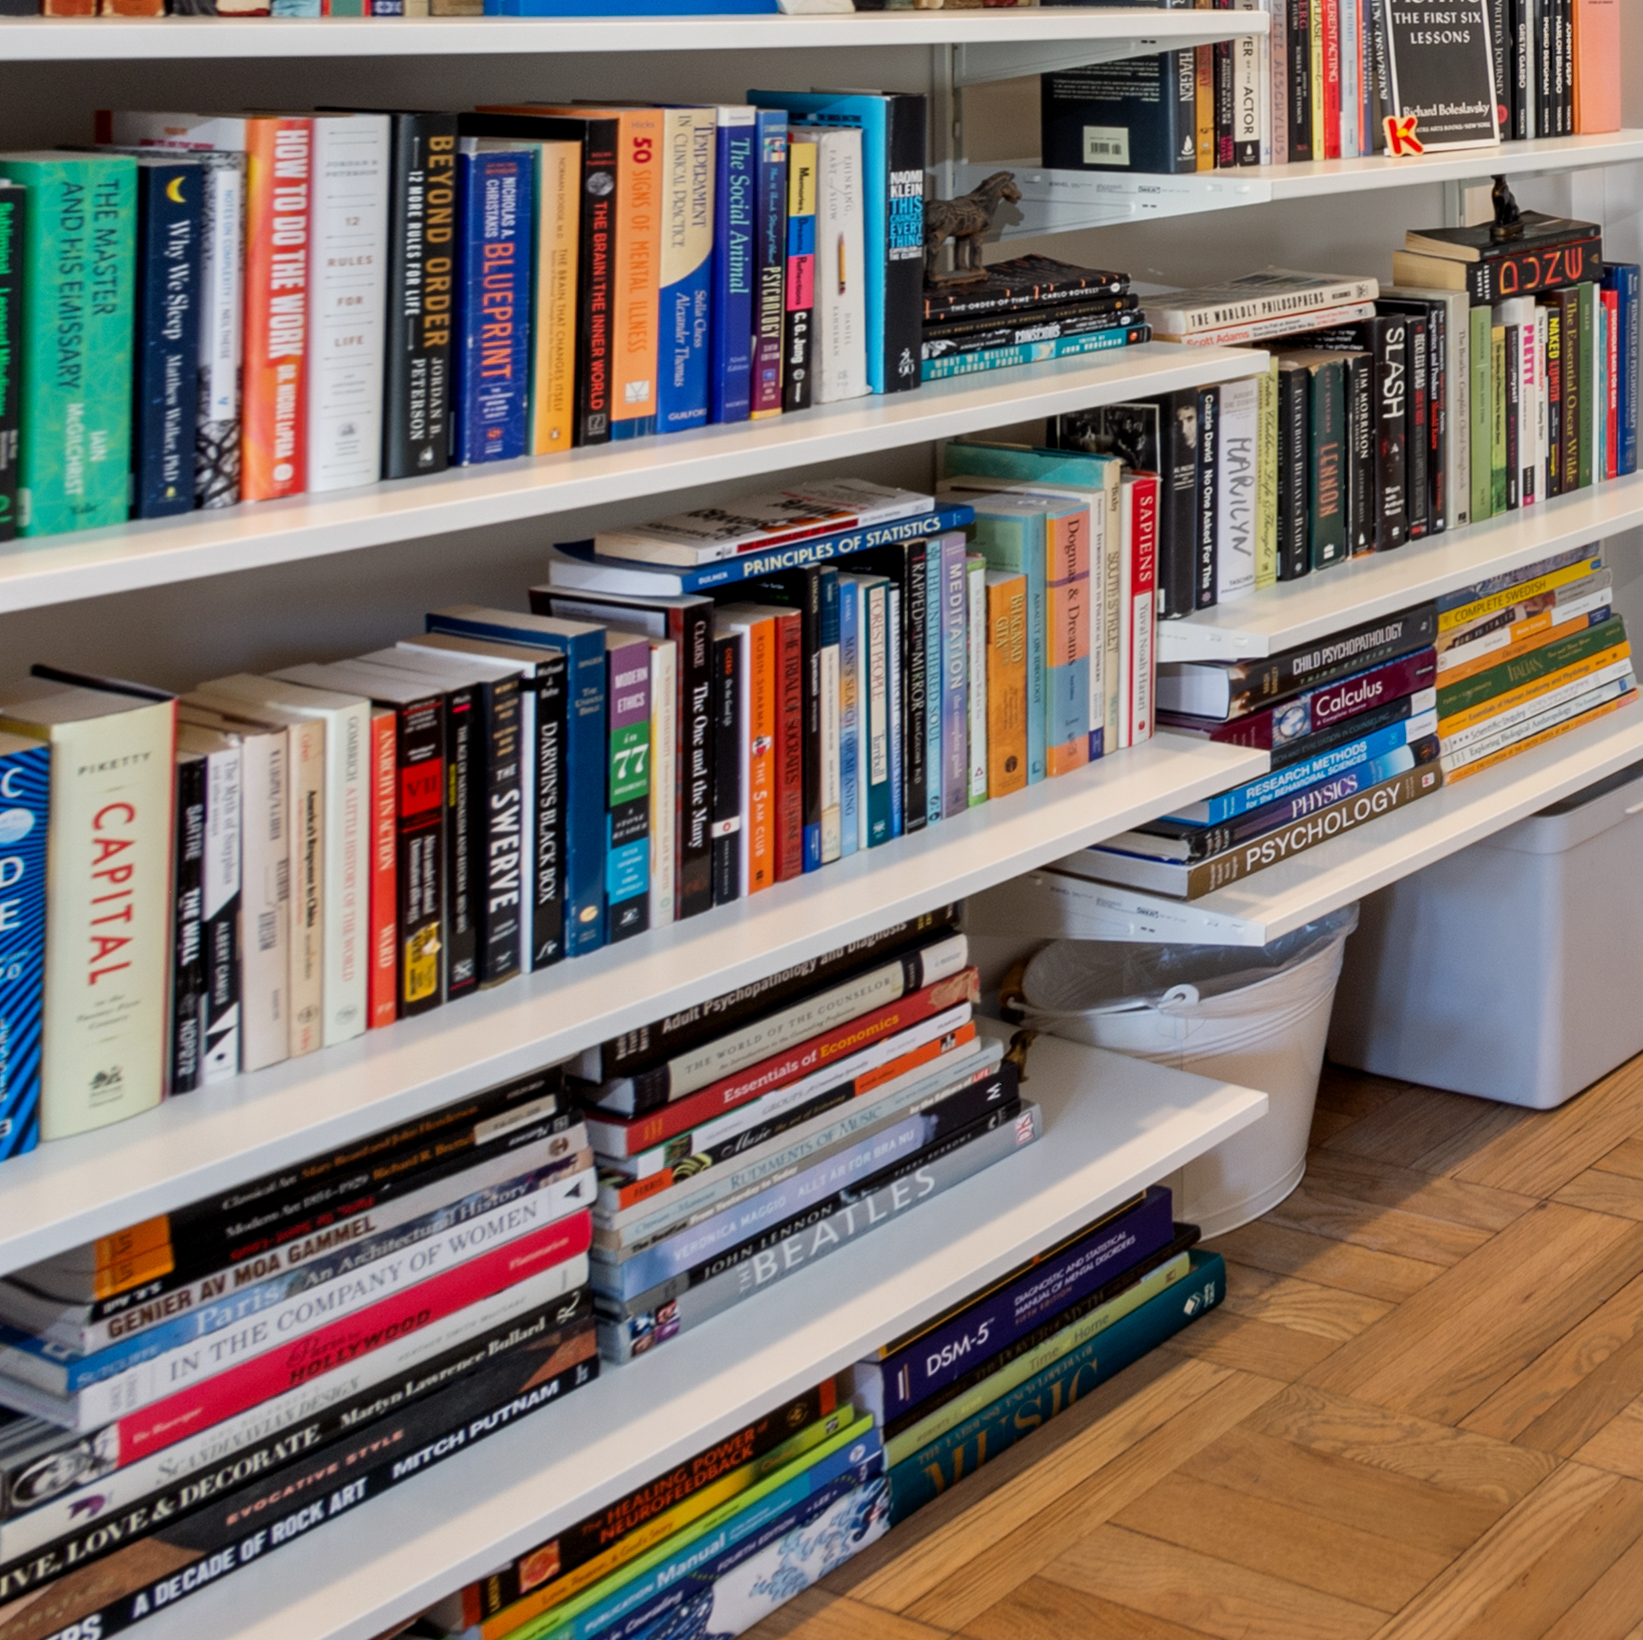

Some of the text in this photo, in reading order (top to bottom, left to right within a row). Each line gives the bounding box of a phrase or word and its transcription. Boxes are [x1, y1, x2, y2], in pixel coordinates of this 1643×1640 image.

[1394, 12, 1481, 24] THE FIRST SIX
[1410, 31, 1470, 44] LESSONS
[1179, 52, 1193, 102] HAGEN
[1402, 101, 1490, 117] Richard Boleslavsky
[633, 137, 653, 164] 50
[890, 171, 923, 185] NAOMI
[728, 139, 749, 294] The Social Animal
[890, 184, 922, 198] KLEIN
[890, 197, 922, 214] THIS
[890, 223, 922, 235] EVERY
[92, 179, 119, 316] THE MASTER
[162, 220, 190, 340] Why We Sleep
[269, 131, 309, 358] HOW TO DO THE WORK
[424, 135, 454, 349] BEYOND ORDER
[889, 235, 923, 246] THING
[57, 182, 84, 392] AND HIS EMISSARY
[481, 242, 514, 379] BLUEPRINT
[761, 266, 781, 338] PSYCHOLOGY
[1190, 292, 1325, 327] THE WORLDLY PHILOSOPHERS
[1382, 327, 1404, 419] SLASH
[743, 517, 941, 577] PRINCIPLES OF STATISTICS
[1139, 496, 1153, 583] SAPIENS
[1454, 579, 1547, 624] COMPLETE SWEDISH
[1292, 622, 1403, 675] CHILD PSYCHOPATHOLOGY
[1315, 679, 1384, 718] Calculus
[77, 751, 152, 776] PIKETTY
[613, 745, 648, 778] 77
[1291, 775, 1357, 818] PHYSICS
[490, 789, 519, 913] SWERVE
[539, 722, 558, 905] DARWIN'S BLACK BOX
[1245, 783, 1402, 871] PSYCHOLOGY
[88, 804, 136, 986] CAPITAL
[723, 1013, 900, 1104] Essentials of Economics
[751, 1166, 936, 1287] BEATLES
[108, 1217, 378, 1340] GENIER AV MOA GAMMEL
[169, 1201, 538, 1383] IN THE COMPANY OF WOMEN
[392, 1380, 561, 1479] MITCH PUTNAM
[132, 1476, 369, 1619] A DECADE OF ROCK ART
